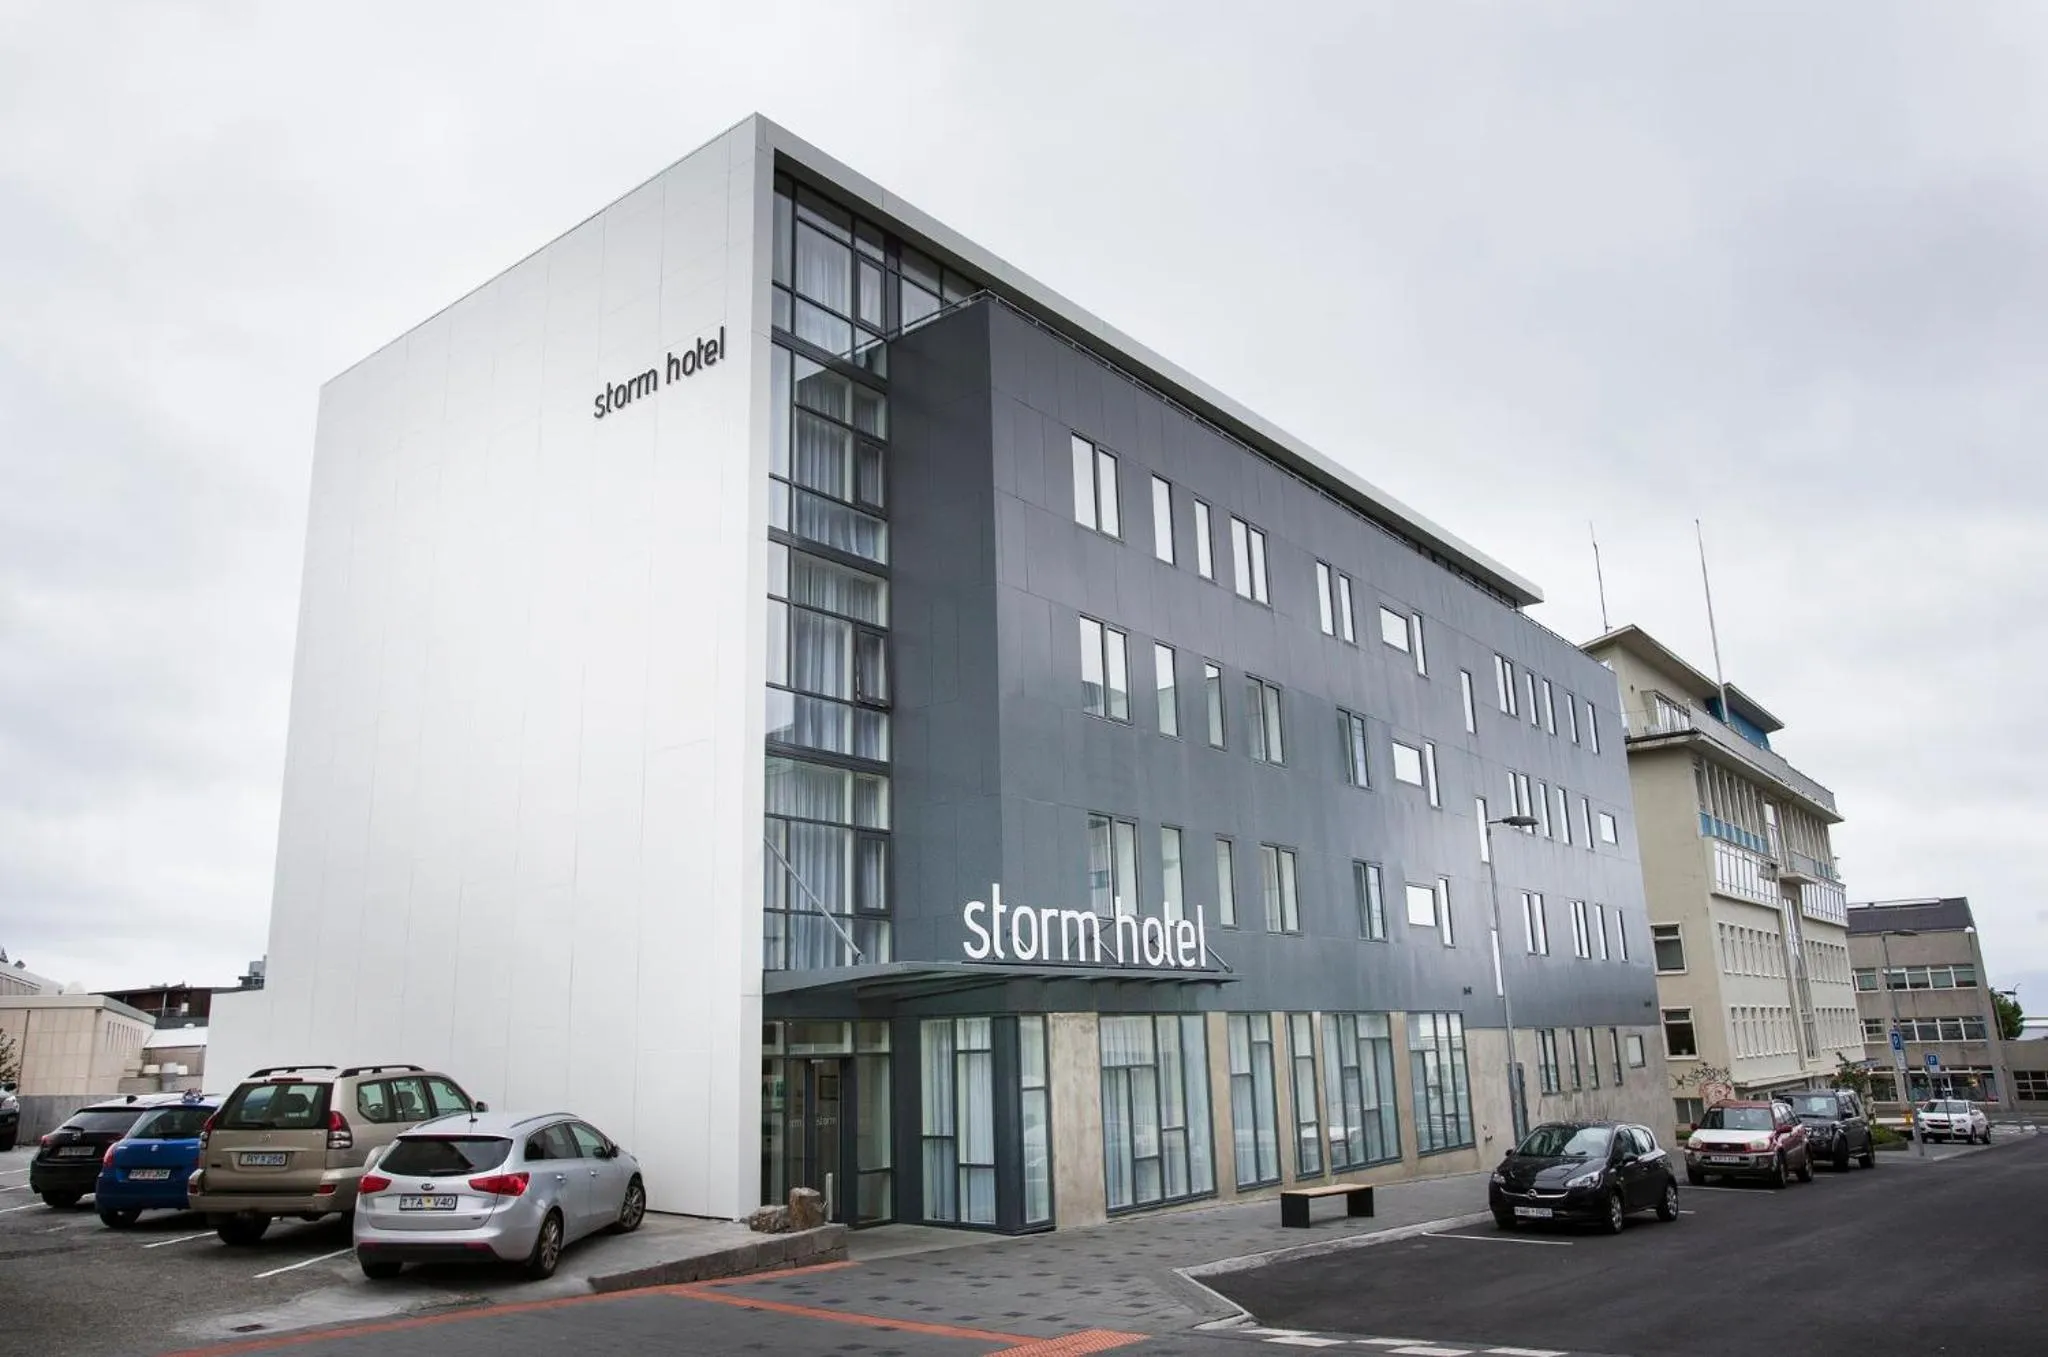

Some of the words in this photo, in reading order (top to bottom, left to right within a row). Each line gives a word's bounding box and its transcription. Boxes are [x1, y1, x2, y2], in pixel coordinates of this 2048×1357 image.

[593, 368, 658, 419] storm
[666, 325, 725, 384] hotel
[963, 883, 1101, 961] storm
[1115, 896, 1206, 968] hotel
